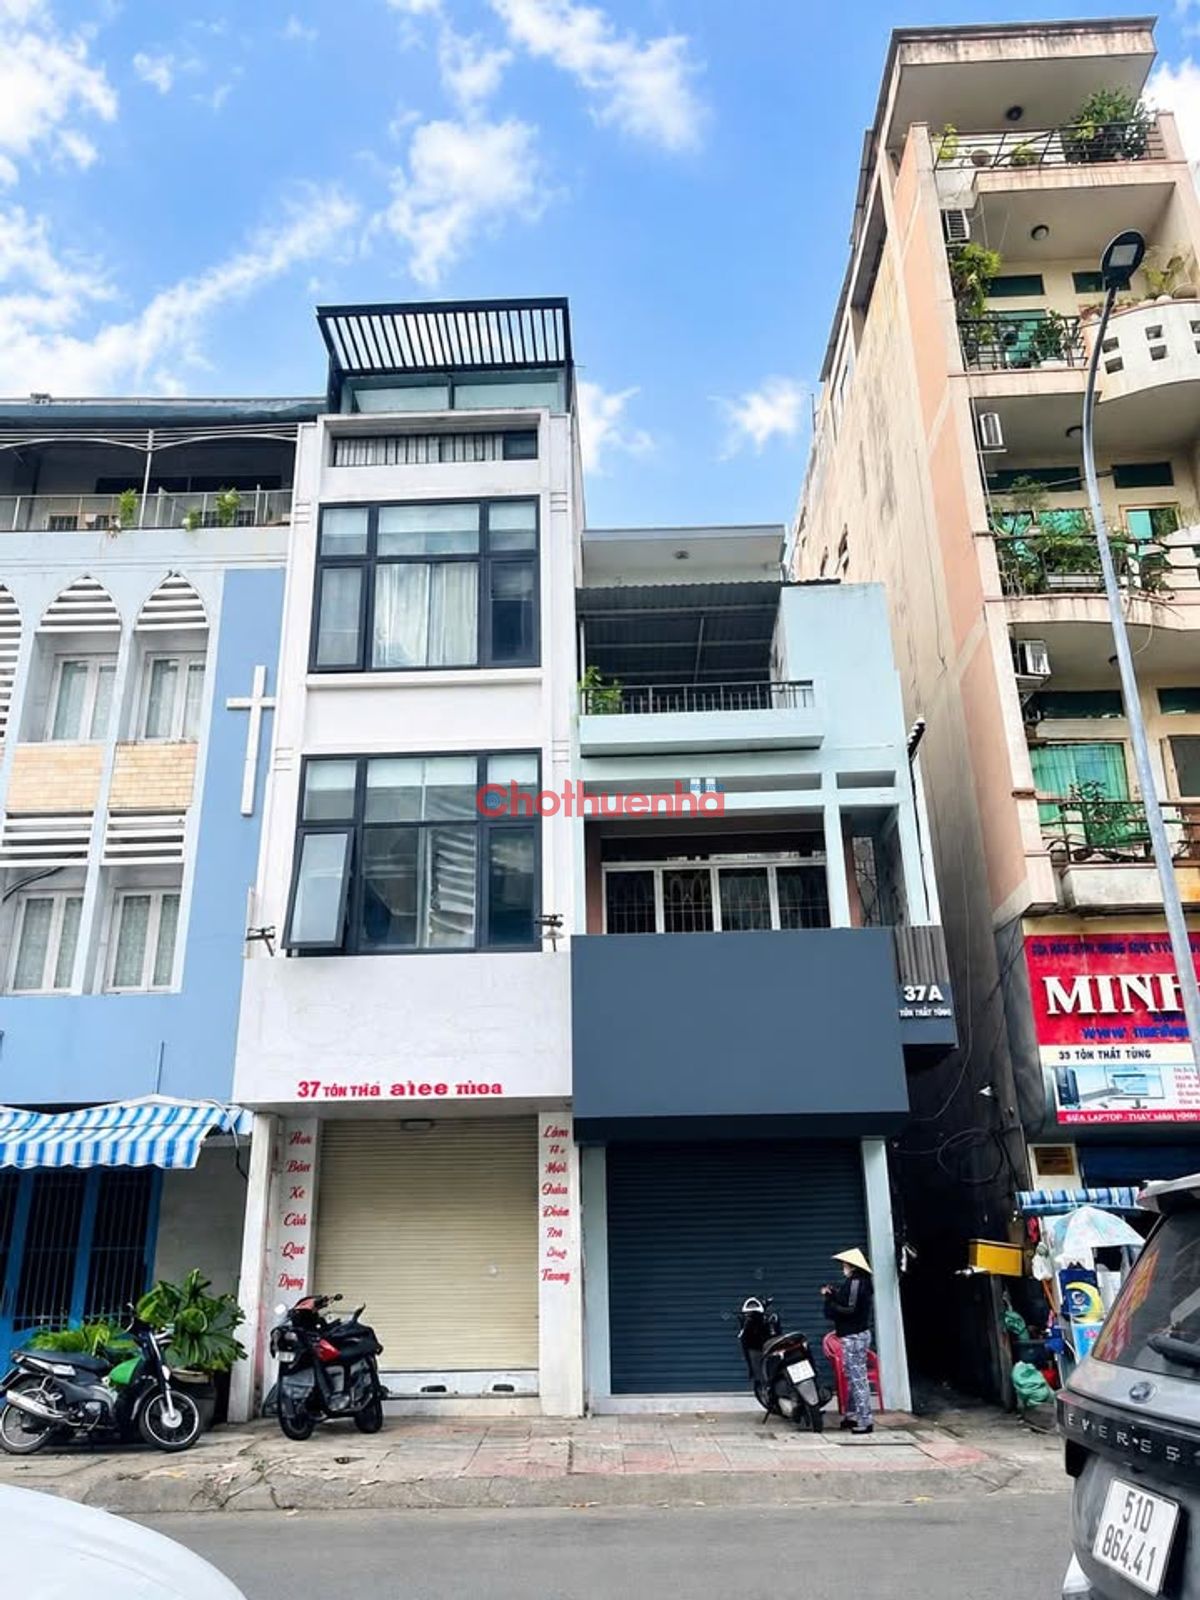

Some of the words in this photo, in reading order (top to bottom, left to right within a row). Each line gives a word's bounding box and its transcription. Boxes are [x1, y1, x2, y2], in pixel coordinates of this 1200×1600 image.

[903, 985, 944, 1001] 37A
[298, 1081, 320, 1097] 37
[1122, 1490, 1154, 1534] 51D
[1102, 1523, 1157, 1581] 864.41
